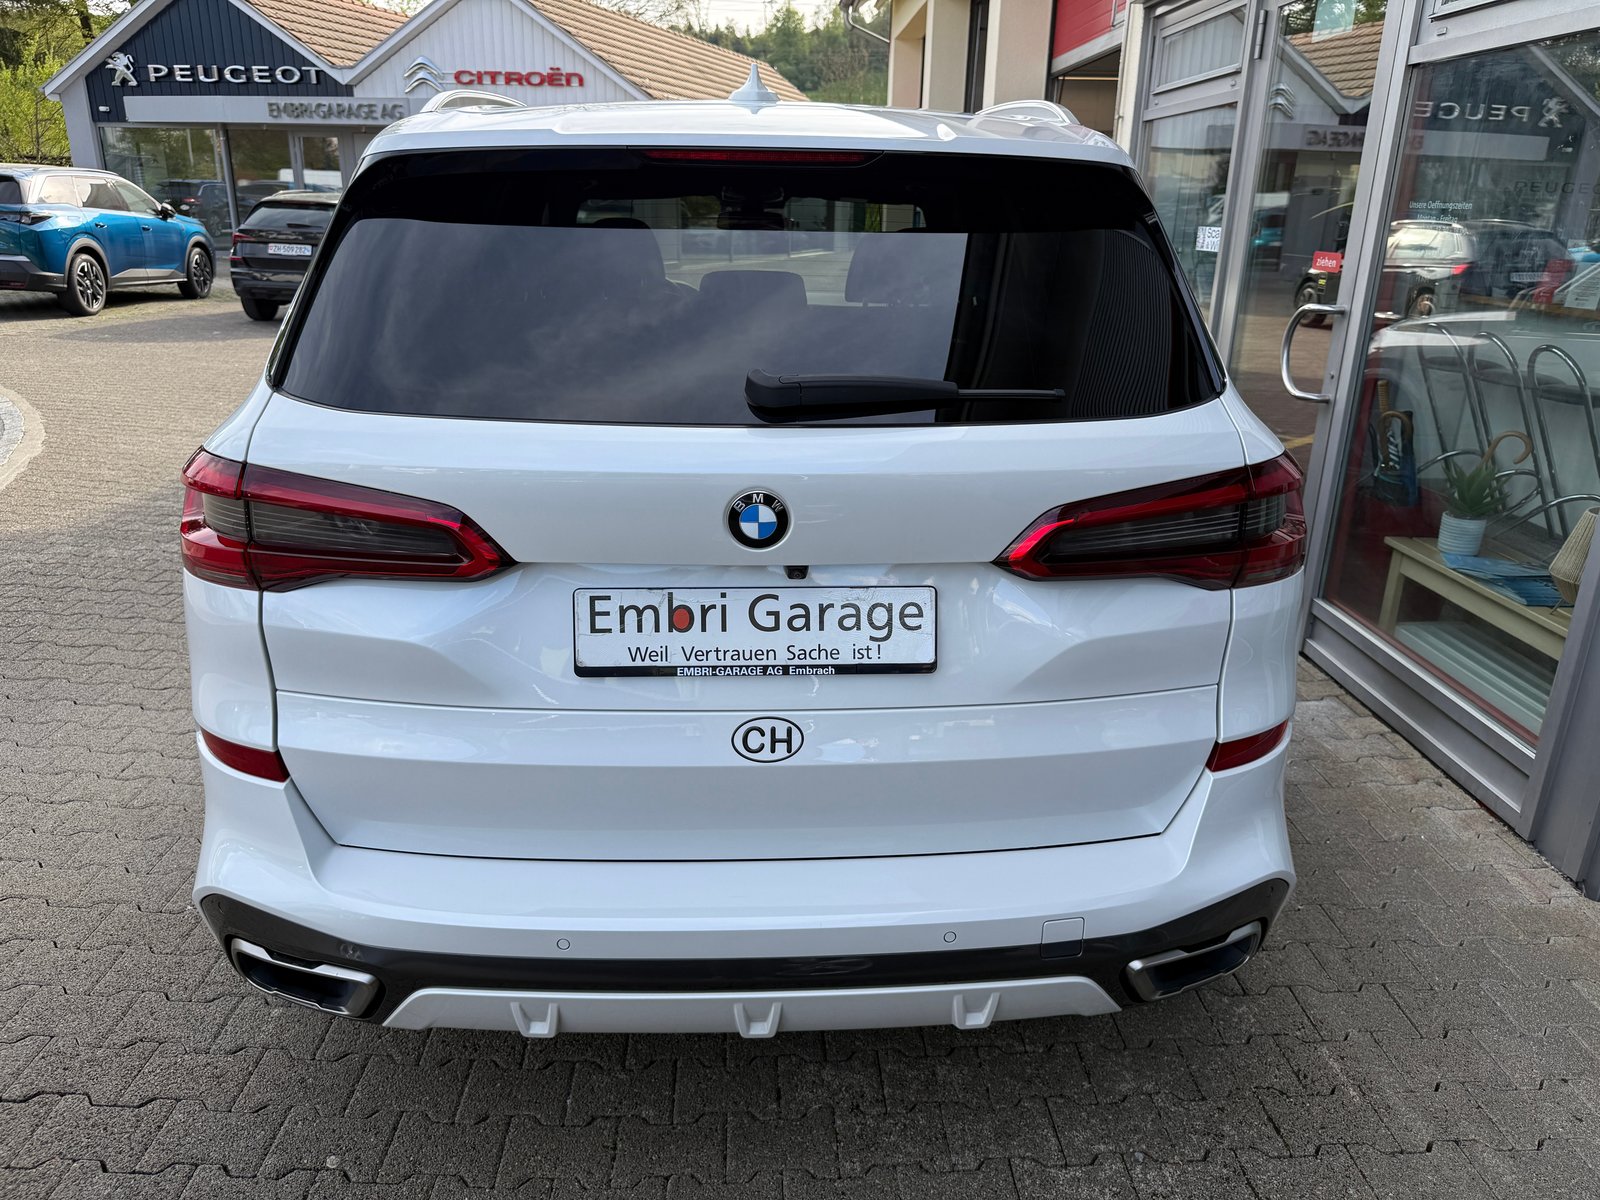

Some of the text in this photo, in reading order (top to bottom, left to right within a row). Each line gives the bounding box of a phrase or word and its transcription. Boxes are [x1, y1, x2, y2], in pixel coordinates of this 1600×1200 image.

[147, 64, 323, 84] PEUGEOT
[454, 67, 584, 87] CITROËN
[268, 102, 404, 120] EMBRI-GARAGE AG
[1409, 200, 1473, 212] Unsere Oeffnungszeiten
[1316, 256, 1337, 268] ziehen
[733, 493, 784, 512] BMW
[589, 592, 924, 643] Embri Garage
[628, 645, 668, 662] Weil
[681, 646, 777, 662] Vertrauen
[787, 643, 840, 661] Sache
[677, 665, 835, 676] EMBRI-GARAGE AG Embrach
[741, 725, 793, 754] CH
